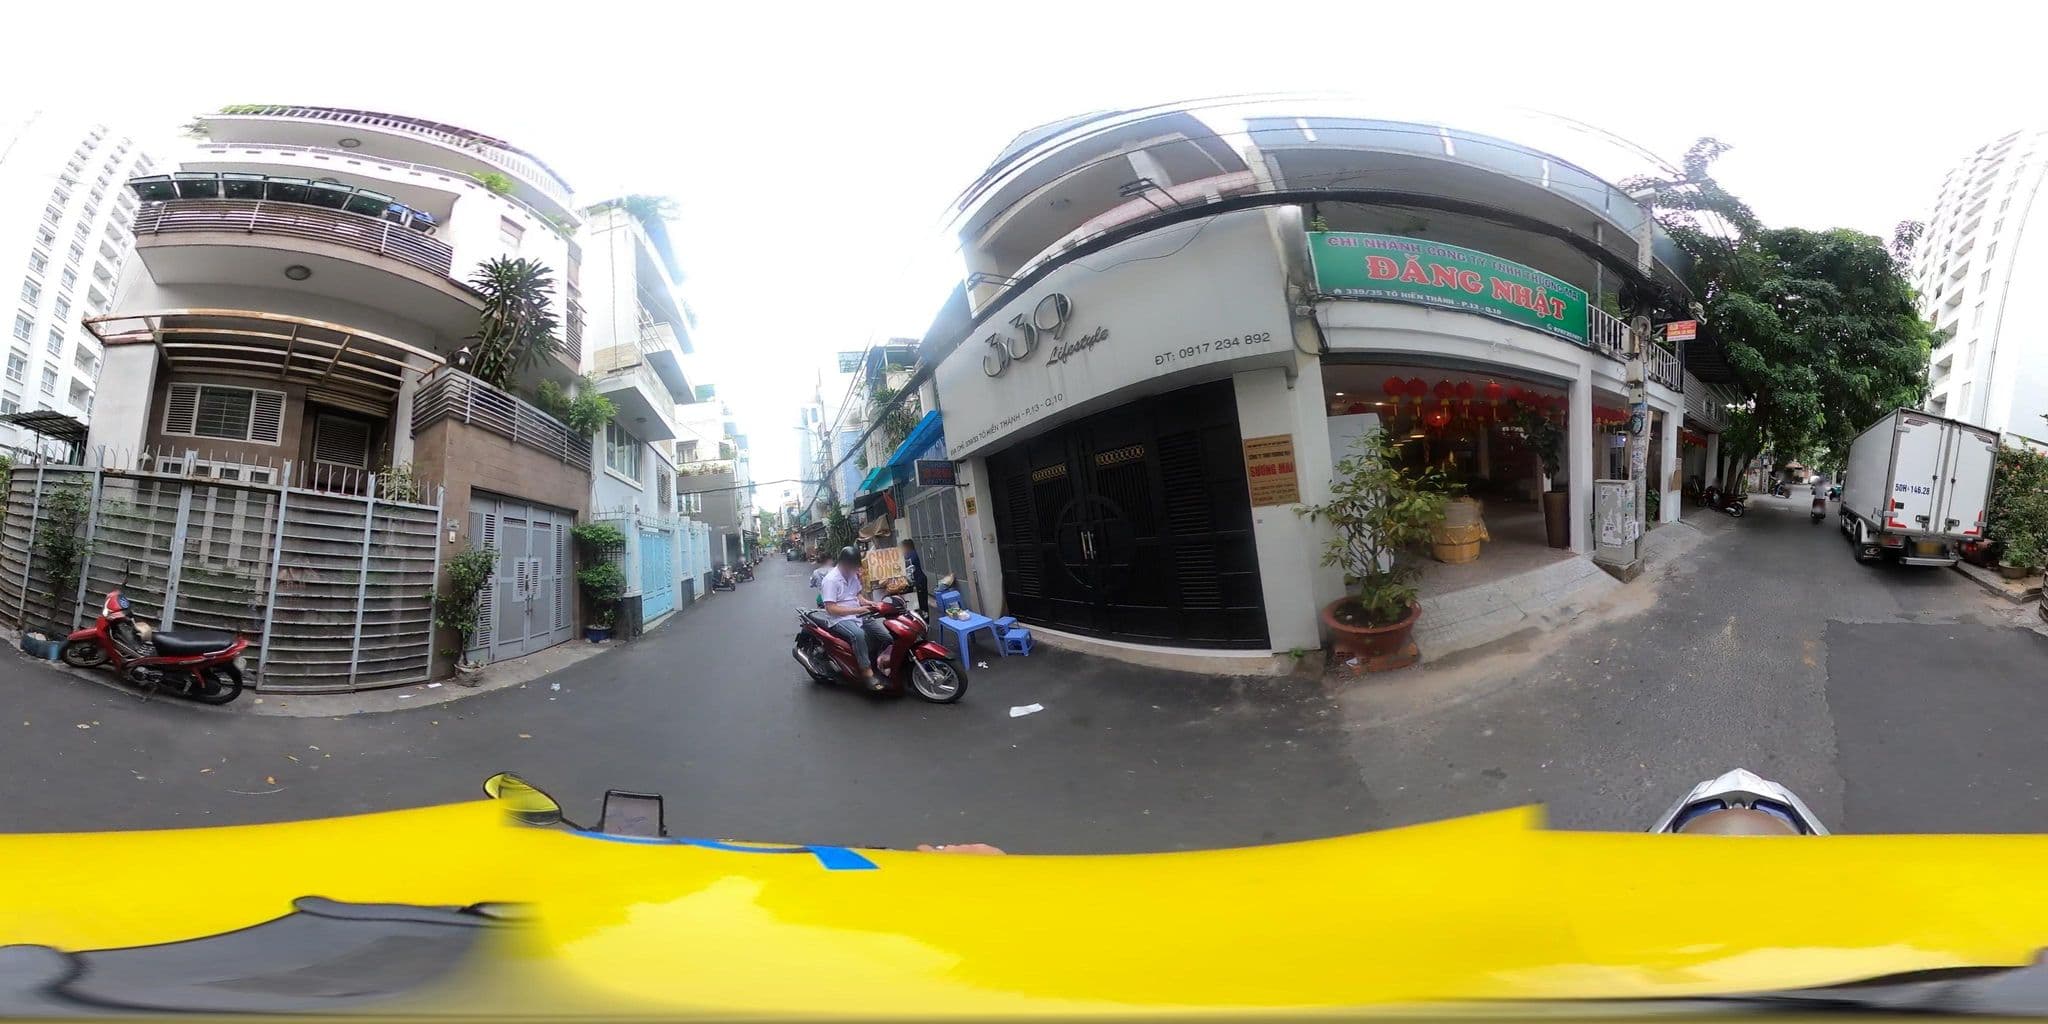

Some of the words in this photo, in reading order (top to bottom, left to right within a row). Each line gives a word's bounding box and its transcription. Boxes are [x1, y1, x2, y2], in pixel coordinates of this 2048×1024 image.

[1327, 237, 1358, 247] CHI
[1470, 255, 1487, 267] TY
[1365, 253, 1484, 295] ĐĂNG
[1490, 276, 1567, 320] NHẬT
[983, 292, 1073, 378] 339
[1045, 325, 1110, 368] Lifestyle
[1154, 351, 1176, 365] ĐT:
[1178, 343, 1210, 358] 0917
[1214, 337, 1241, 351] 234
[1244, 332, 1271, 345] 892
[1044, 393, 1064, 408] Q.10
